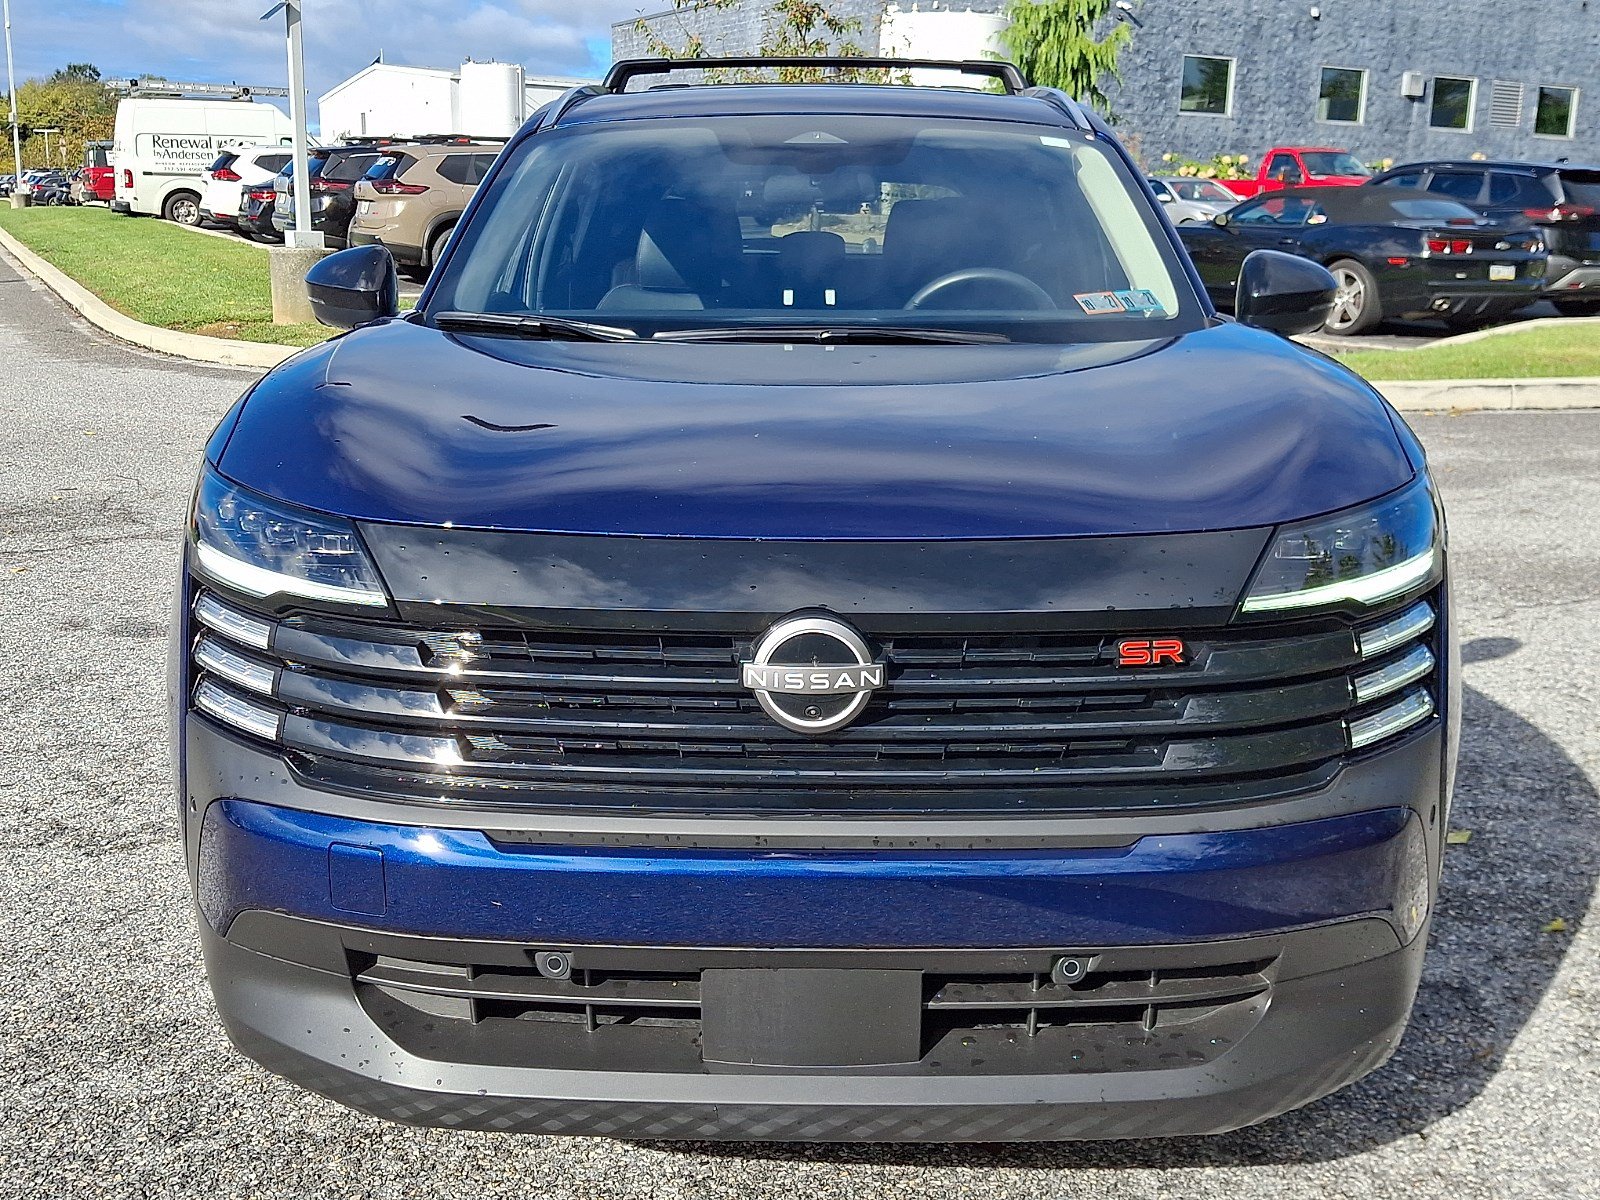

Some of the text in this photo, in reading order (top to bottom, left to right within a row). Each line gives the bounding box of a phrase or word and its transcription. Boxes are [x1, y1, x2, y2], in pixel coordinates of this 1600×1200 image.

[152, 134, 213, 149] Renewal
[1120, 640, 1184, 665] SR
[747, 669, 881, 690] NISSAN
